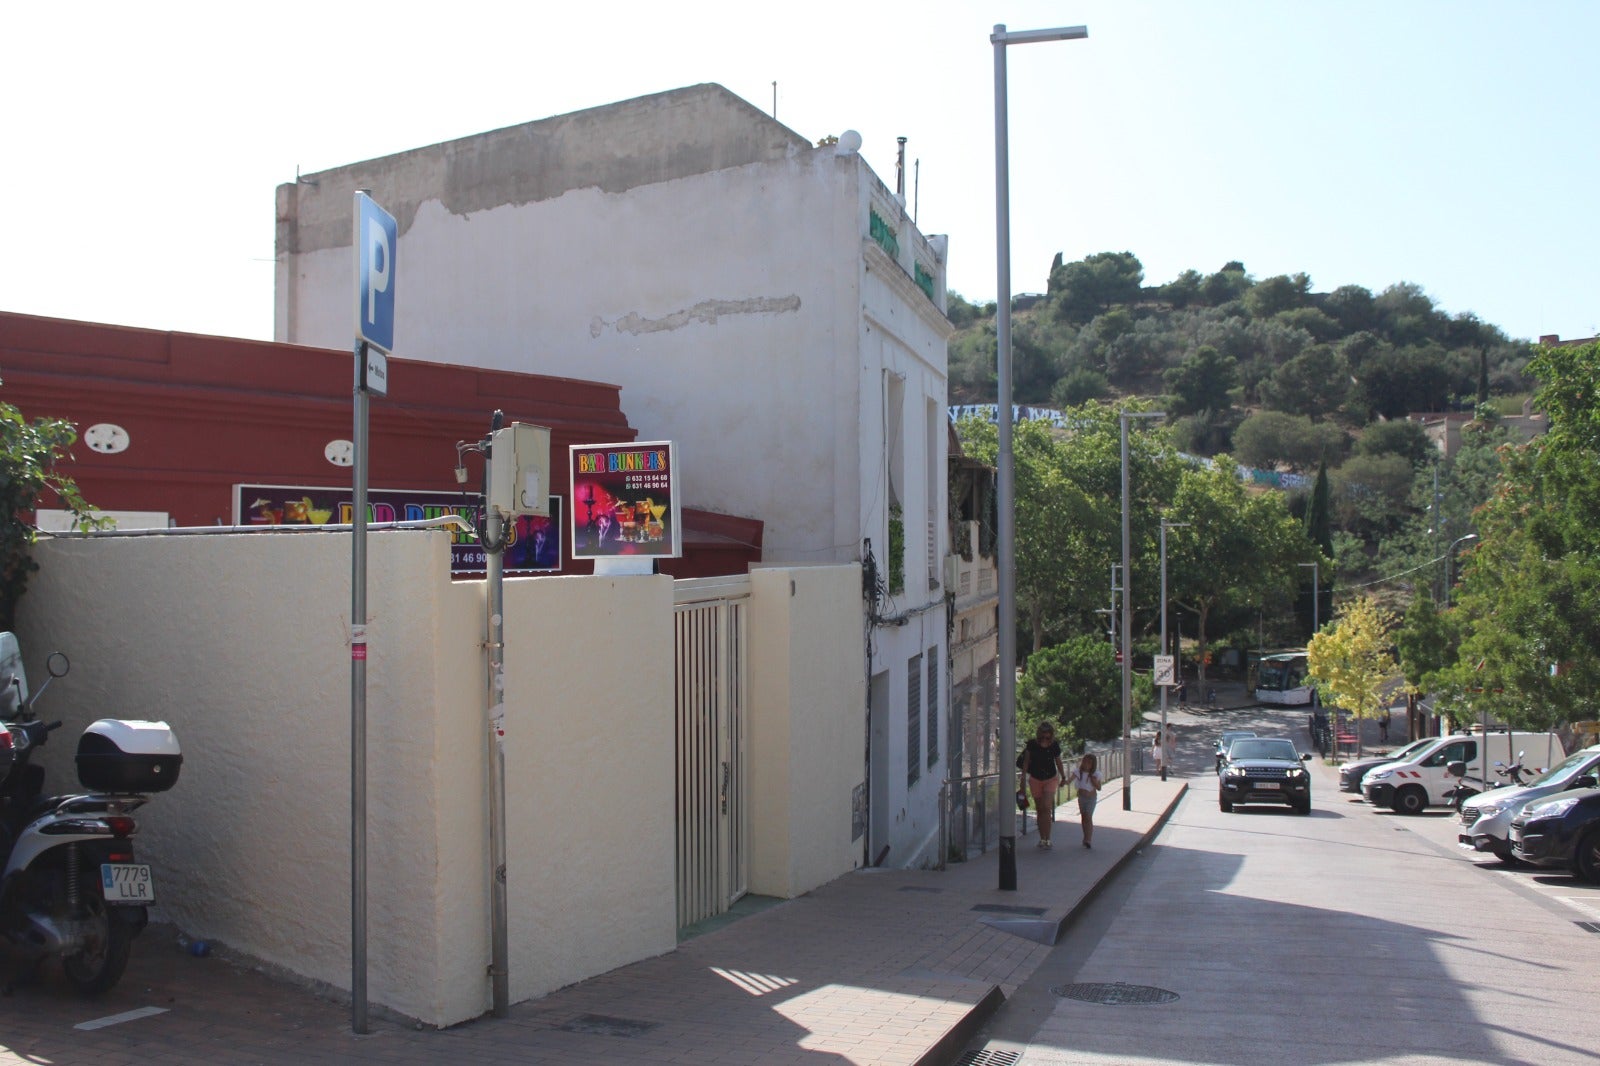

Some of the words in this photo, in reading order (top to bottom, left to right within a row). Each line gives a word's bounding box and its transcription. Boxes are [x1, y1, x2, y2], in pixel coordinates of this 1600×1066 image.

[369, 217, 389, 325] P
[579, 453, 605, 473] BAR
[608, 451, 666, 472] BUNKERS
[463, 553, 474, 563] 46
[476, 553, 487, 563] 90
[1158, 670, 1171, 678] 30
[114, 867, 148, 881] 7779
[120, 883, 146, 897] LLR
